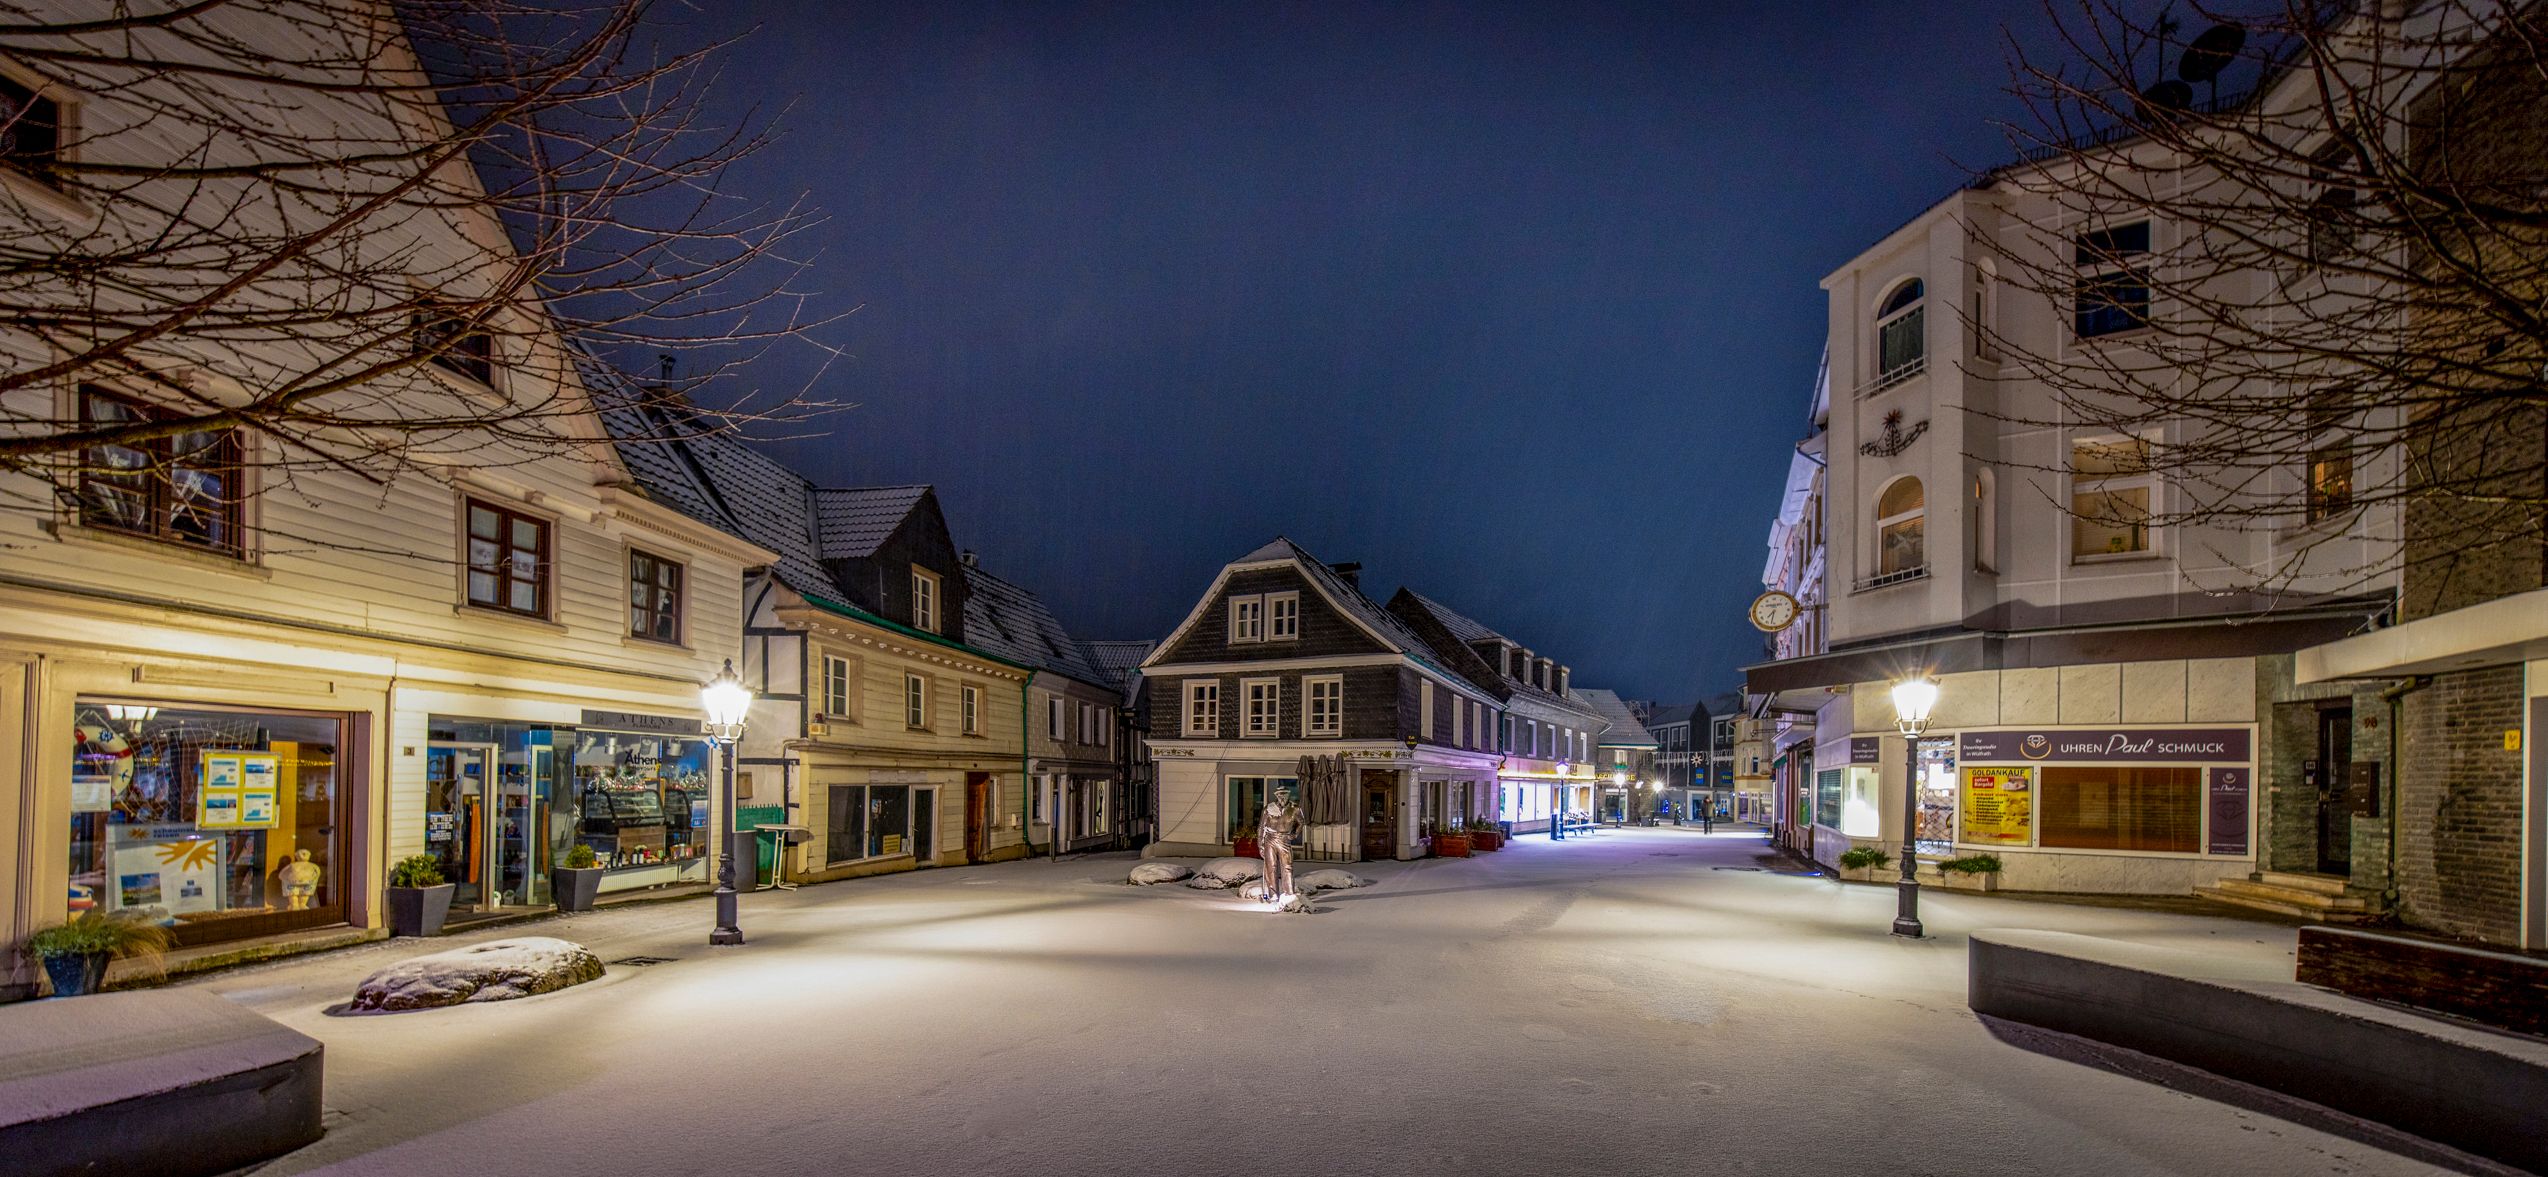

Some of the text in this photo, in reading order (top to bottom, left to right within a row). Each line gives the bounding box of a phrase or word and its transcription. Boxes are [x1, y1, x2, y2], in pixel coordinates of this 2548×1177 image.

[620, 713, 674, 726] ATHENS
[2060, 733, 2224, 755] UHREN Paul SCHMUCK
[1972, 769, 2024, 777] GOLDANKAUF
